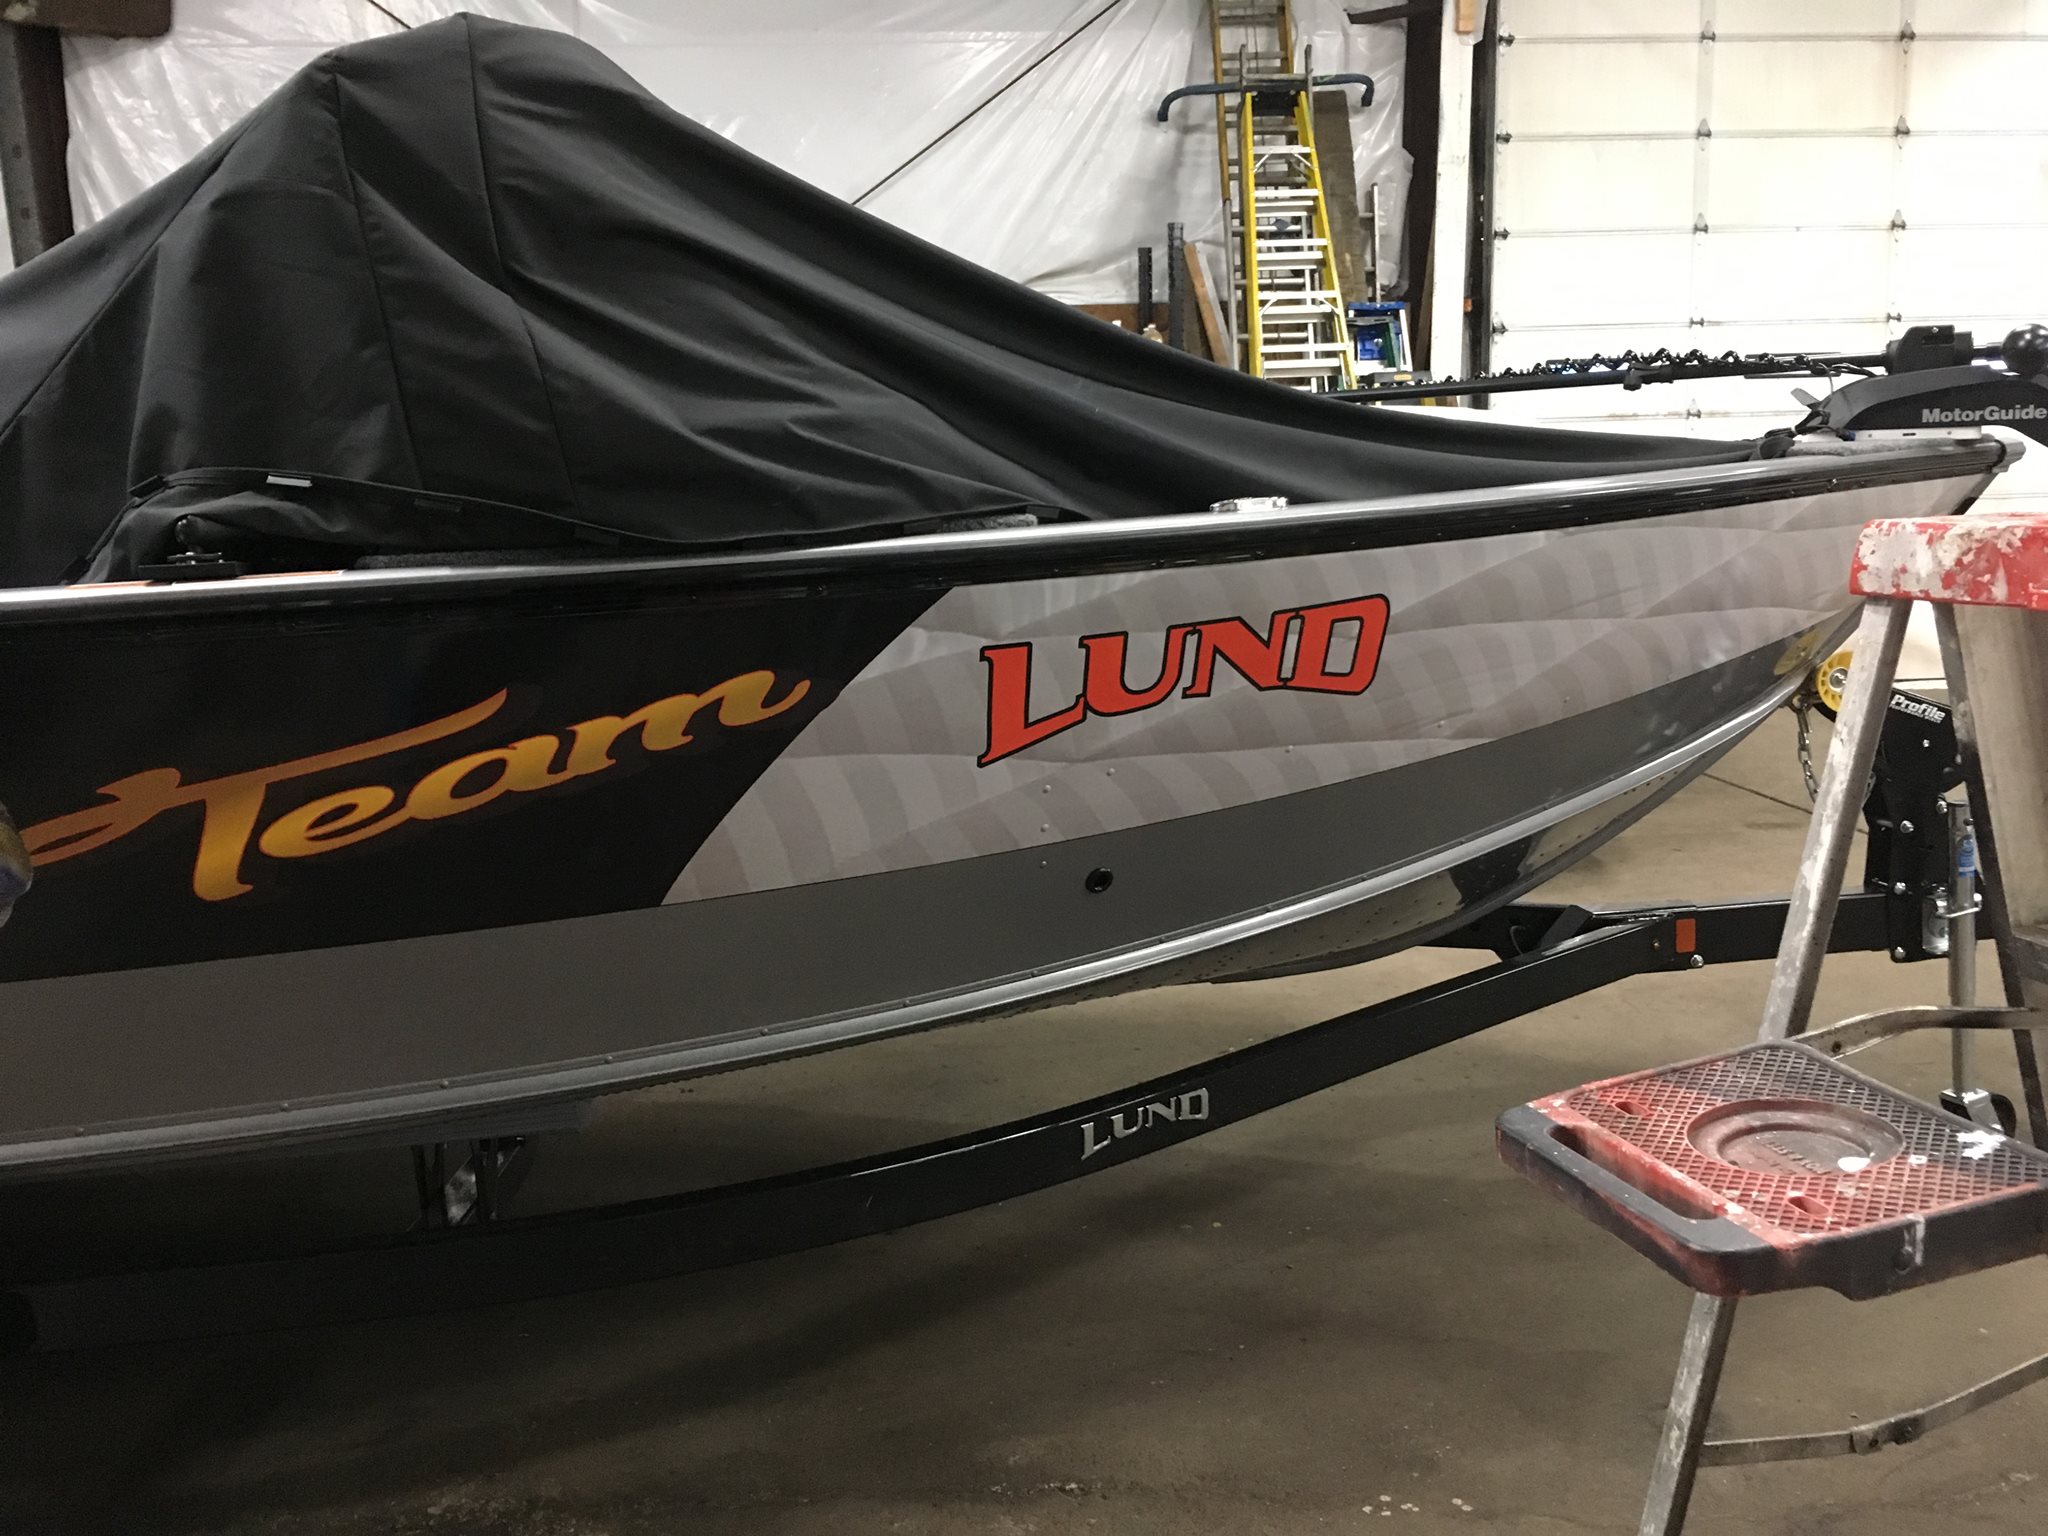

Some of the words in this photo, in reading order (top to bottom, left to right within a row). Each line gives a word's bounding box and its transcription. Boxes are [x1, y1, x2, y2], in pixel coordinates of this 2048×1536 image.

[1921, 404, 2047, 423] MotorGuide
[977, 593, 1390, 768] LUND
[1890, 693, 1946, 720] Profile
[20, 669, 811, 902] Team
[1080, 1087, 1209, 1160] LUND
